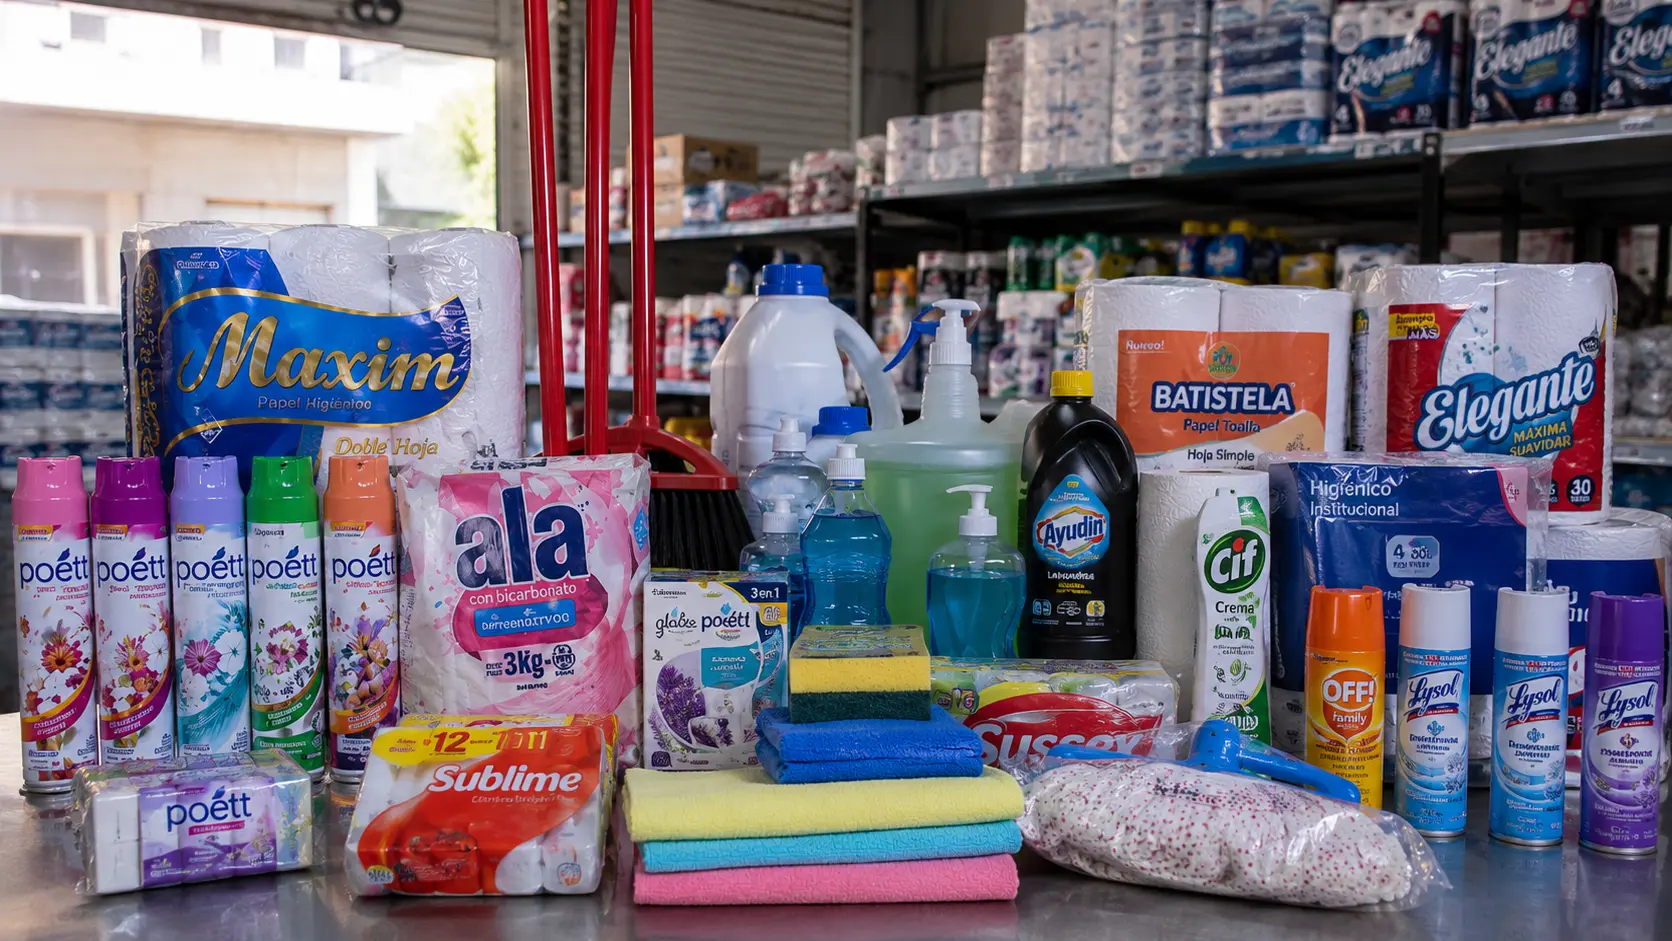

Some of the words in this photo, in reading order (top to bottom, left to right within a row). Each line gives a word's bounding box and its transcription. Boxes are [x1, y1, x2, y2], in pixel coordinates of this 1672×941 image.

[1609, 23, 1672, 66] Eleg
[177, 312, 461, 393] Maxim
[1154, 385, 1292, 411] BATISTELA
[1417, 354, 1596, 449] Elegante
[1184, 419, 1220, 433] Papel
[1513, 421, 1567, 443] MAXIMA
[334, 436, 386, 456] Doble
[391, 437, 438, 456] Hoja
[1571, 479, 1591, 495] 30
[1310, 502, 1400, 516] Institucional
[455, 486, 588, 588] ala
[1043, 515, 1103, 549] Ayudin
[1210, 538, 1258, 584] Cif
[469, 592, 494, 605] con
[495, 586, 577, 603] bicarbonato
[750, 588, 758, 599] 3
[1215, 601, 1254, 614] Crema
[1323, 680, 1375, 703] OFF!
[1408, 672, 1459, 715] Lysol
[1508, 678, 1560, 722] Lysol
[1599, 683, 1654, 727] Lysol
[434, 731, 470, 752] 12
[428, 764, 582, 792] Sublime
